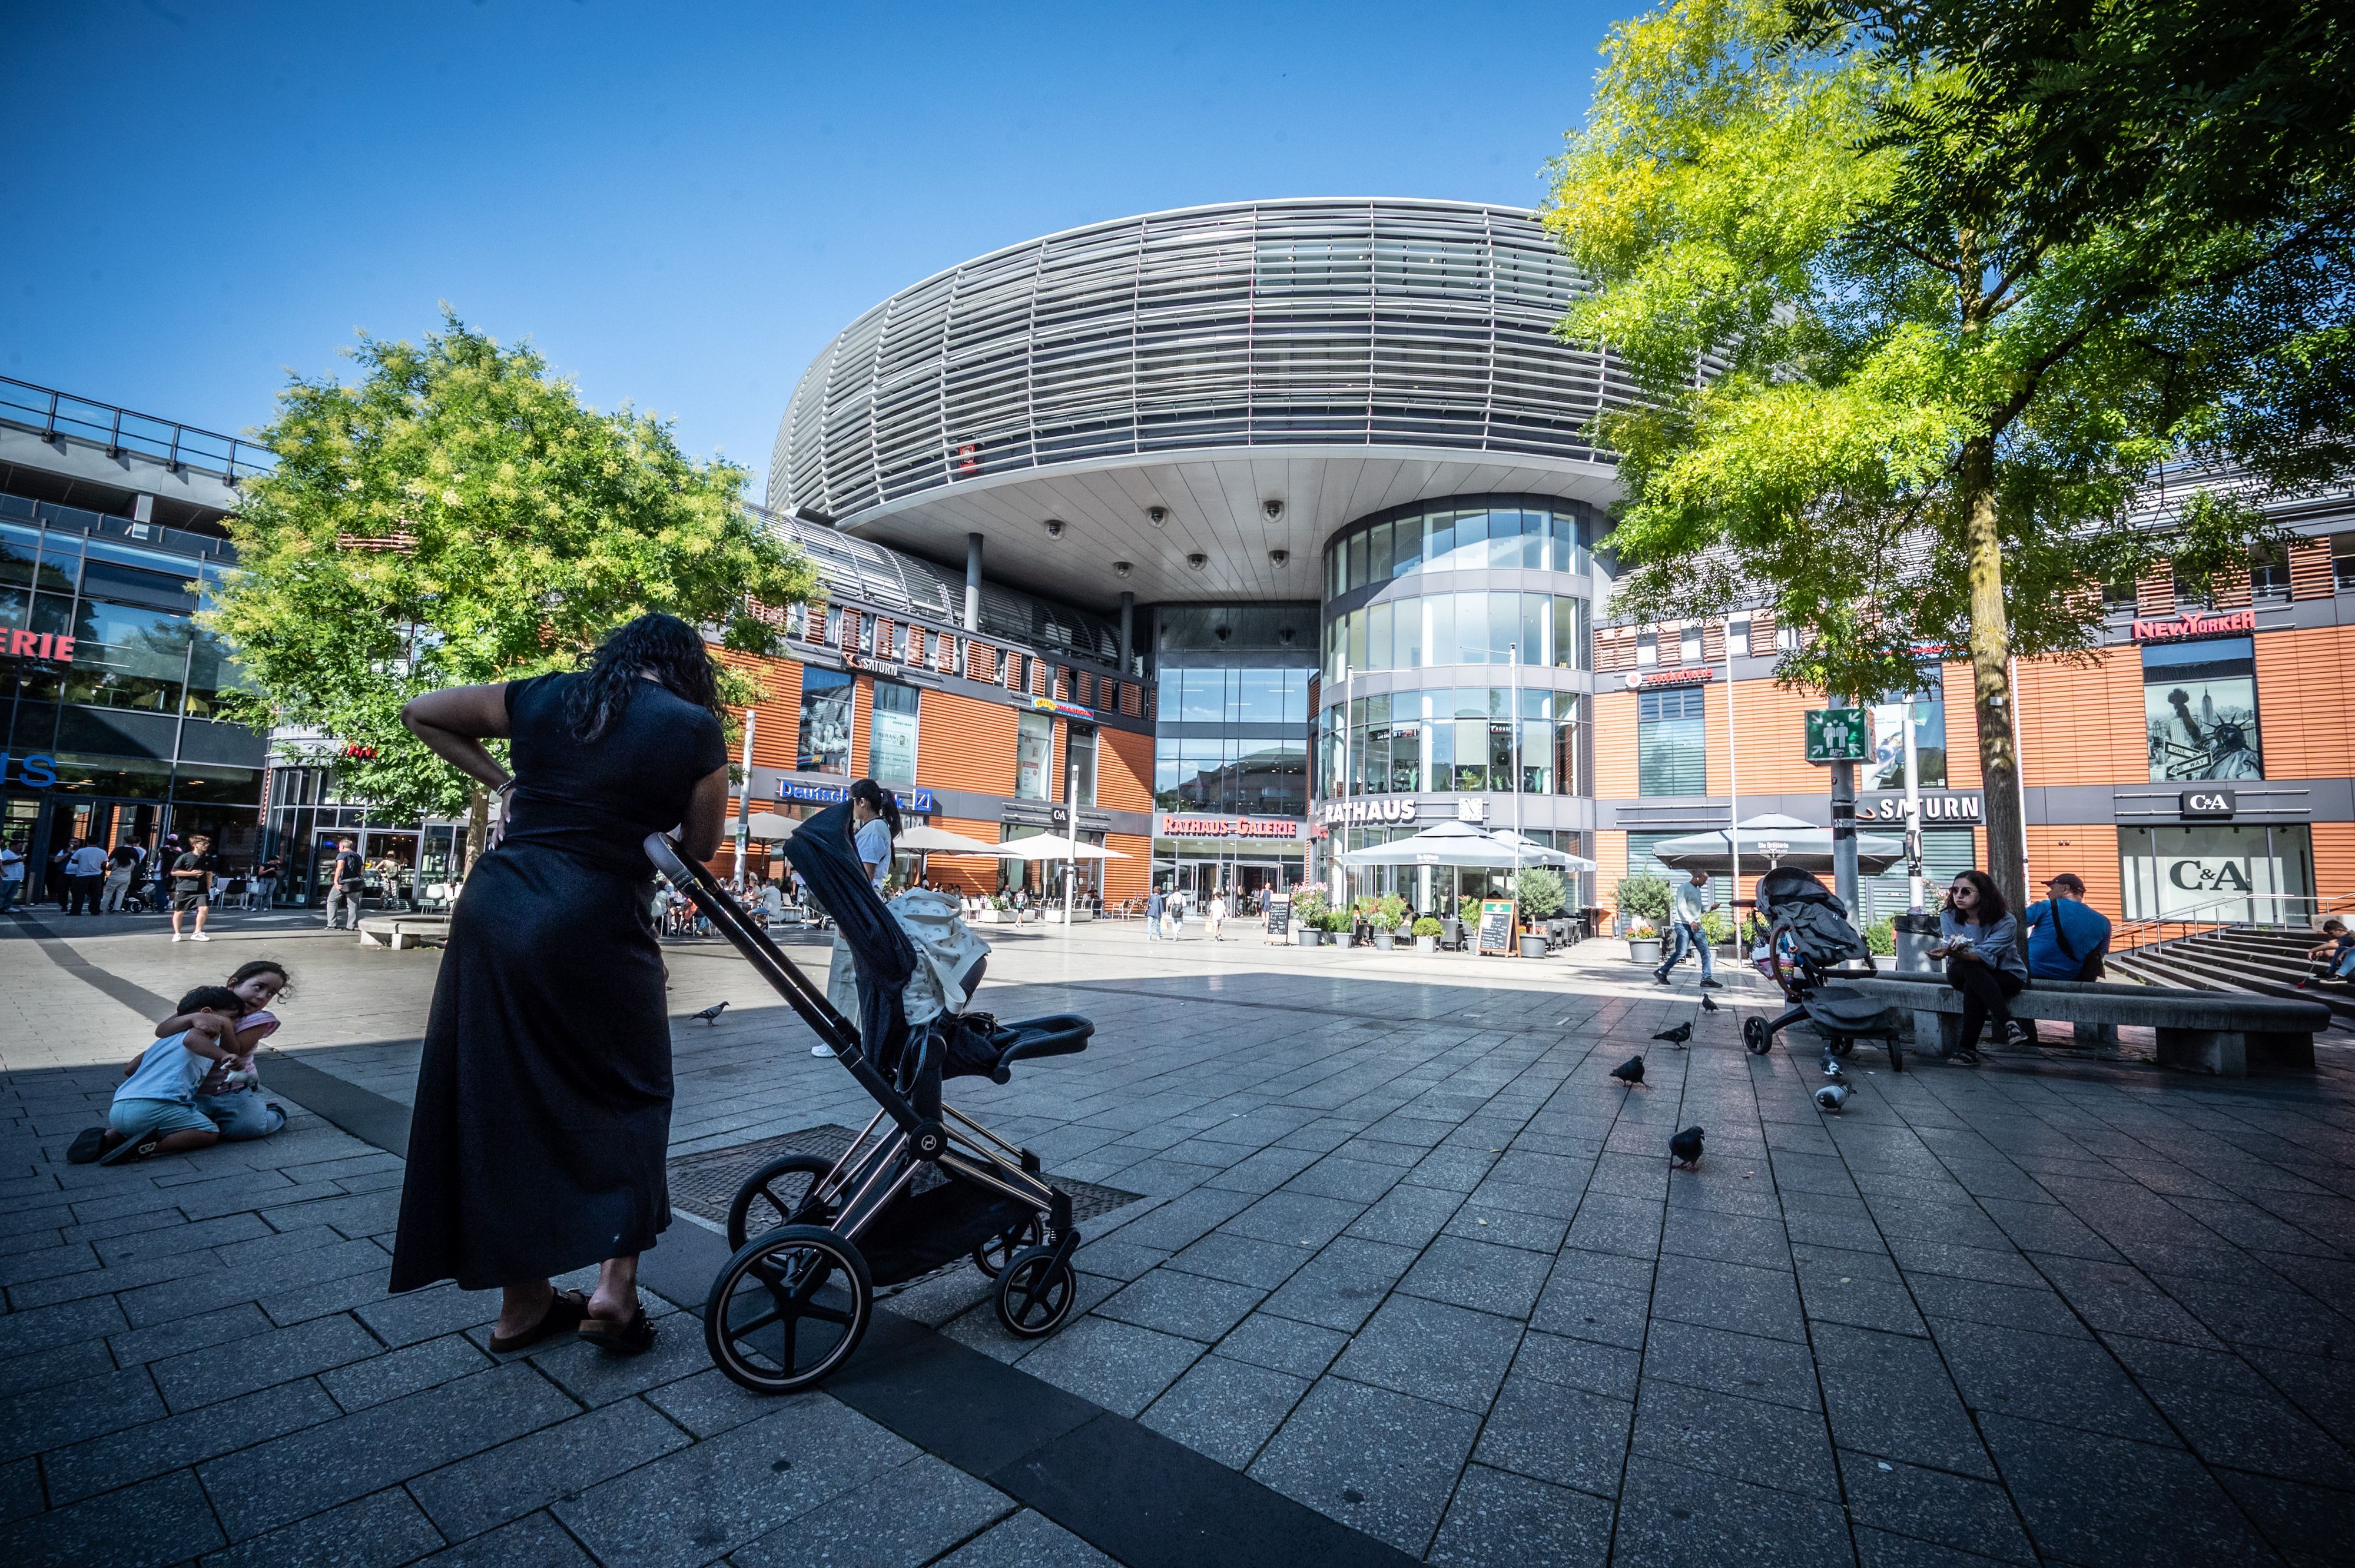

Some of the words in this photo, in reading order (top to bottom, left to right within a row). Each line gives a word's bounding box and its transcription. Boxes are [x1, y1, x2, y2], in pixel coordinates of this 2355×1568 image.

[861, 658, 897, 676] SATURN
[1647, 669, 1713, 683] vodafone
[1035, 698, 1056, 710] SMYTHS
[2172, 747, 2186, 755] ONE
[2190, 759, 2204, 768] WAY
[780, 781, 849, 802] Deutsch
[2190, 794, 2230, 810] C&A
[1053, 810, 1066, 820] C&A
[1325, 799, 1416, 823] RATHAUS
[2170, 860, 2253, 891] C&A
